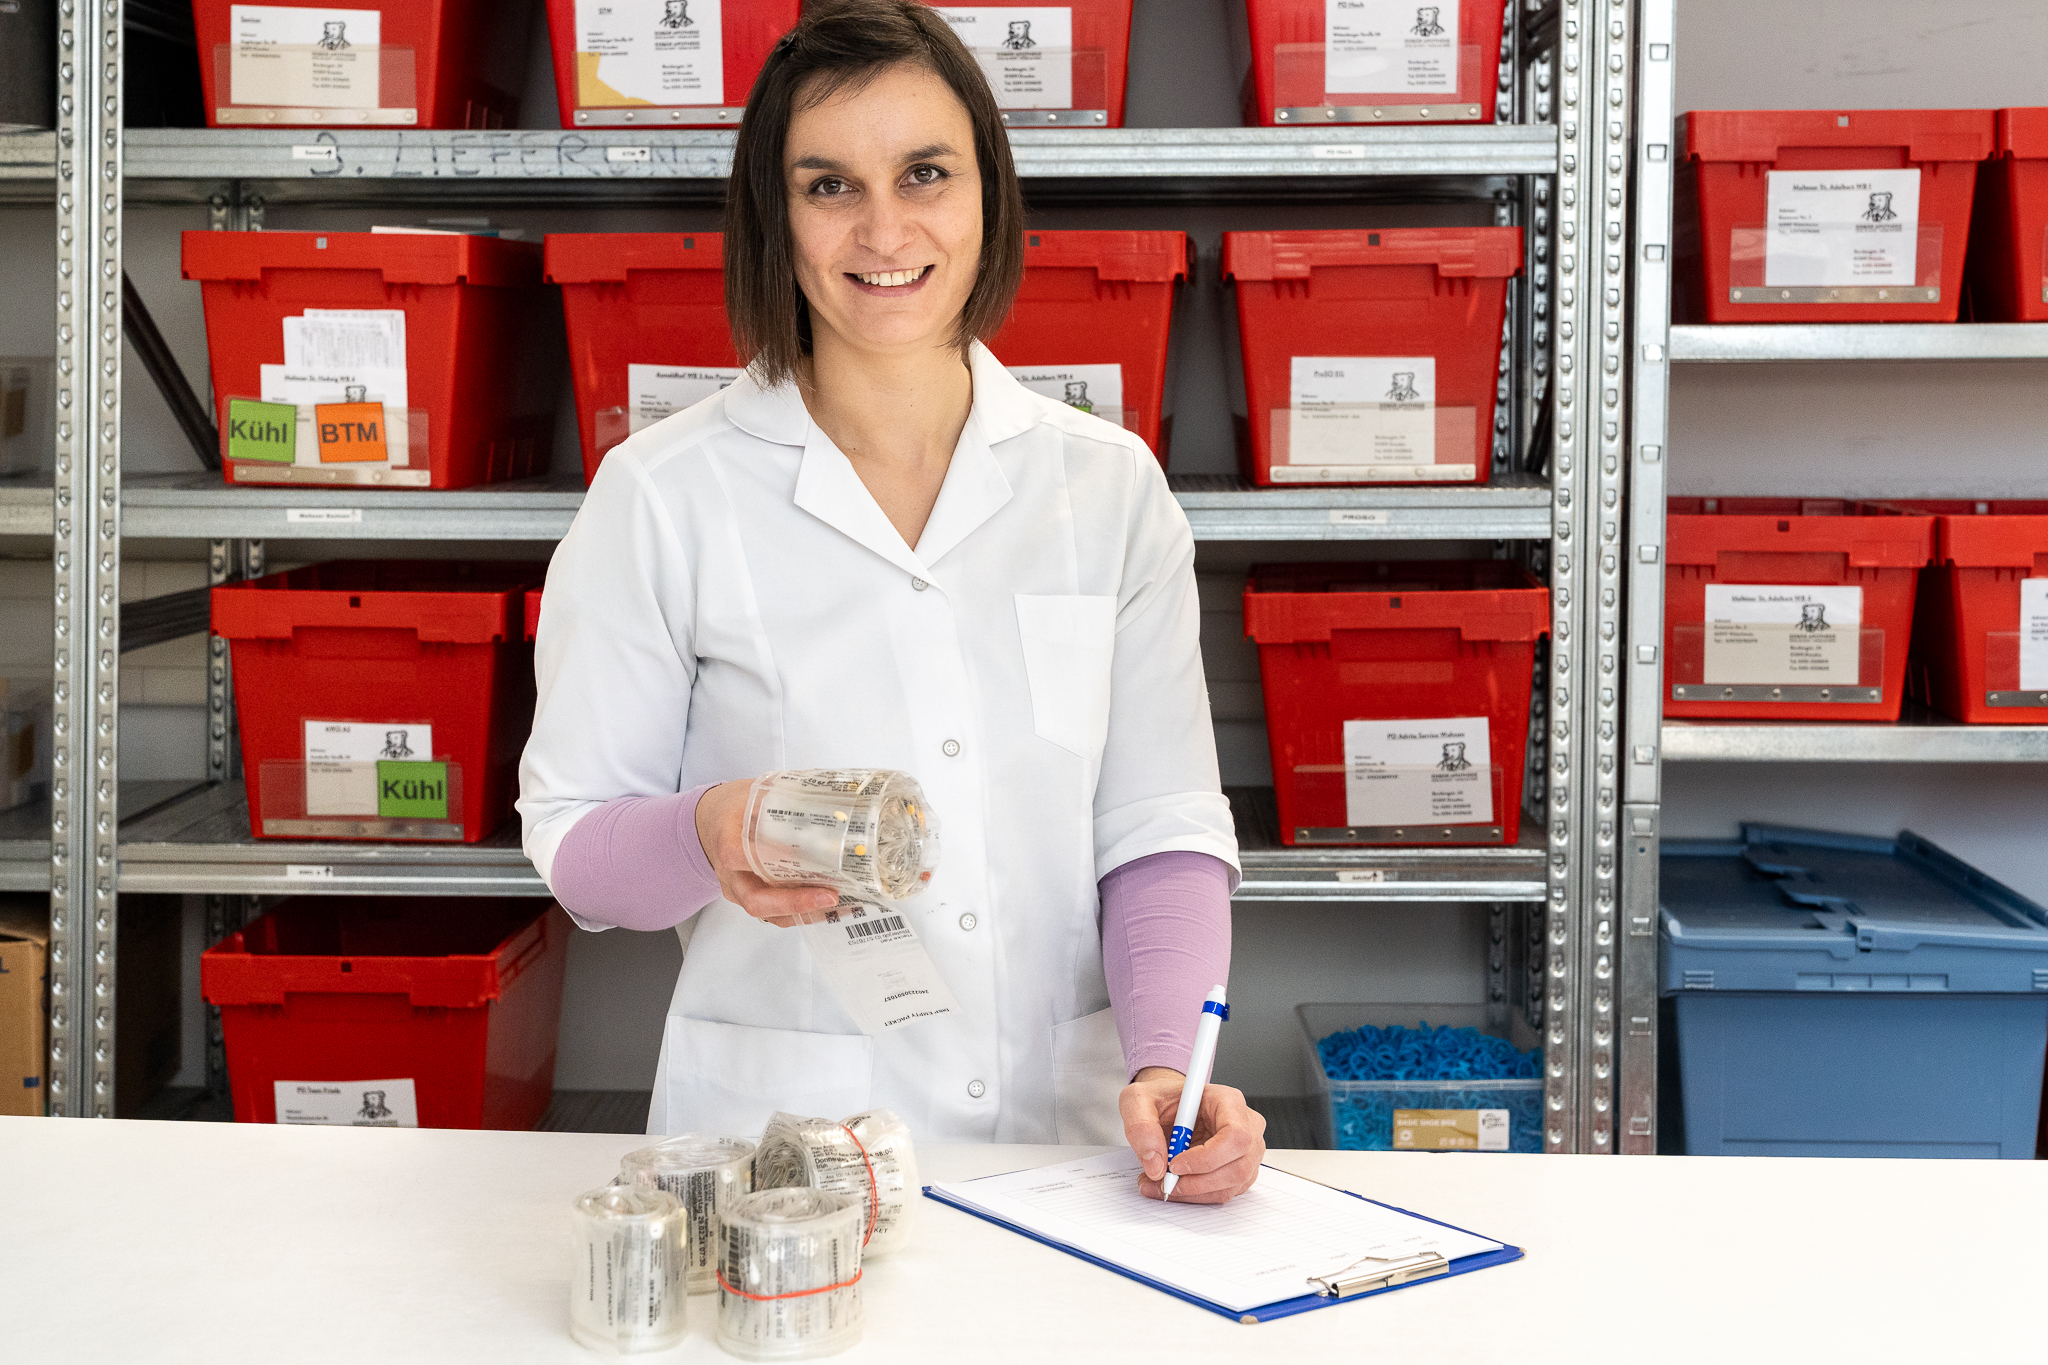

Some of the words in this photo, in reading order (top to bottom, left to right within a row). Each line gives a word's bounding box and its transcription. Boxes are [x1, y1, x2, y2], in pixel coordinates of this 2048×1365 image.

[231, 418, 288, 444] Kühl
[321, 422, 378, 444] BTM
[382, 780, 442, 800] Kühl
[884, 1014, 910, 1026] PACKET
[698, 1247, 706, 1267] 07:30
